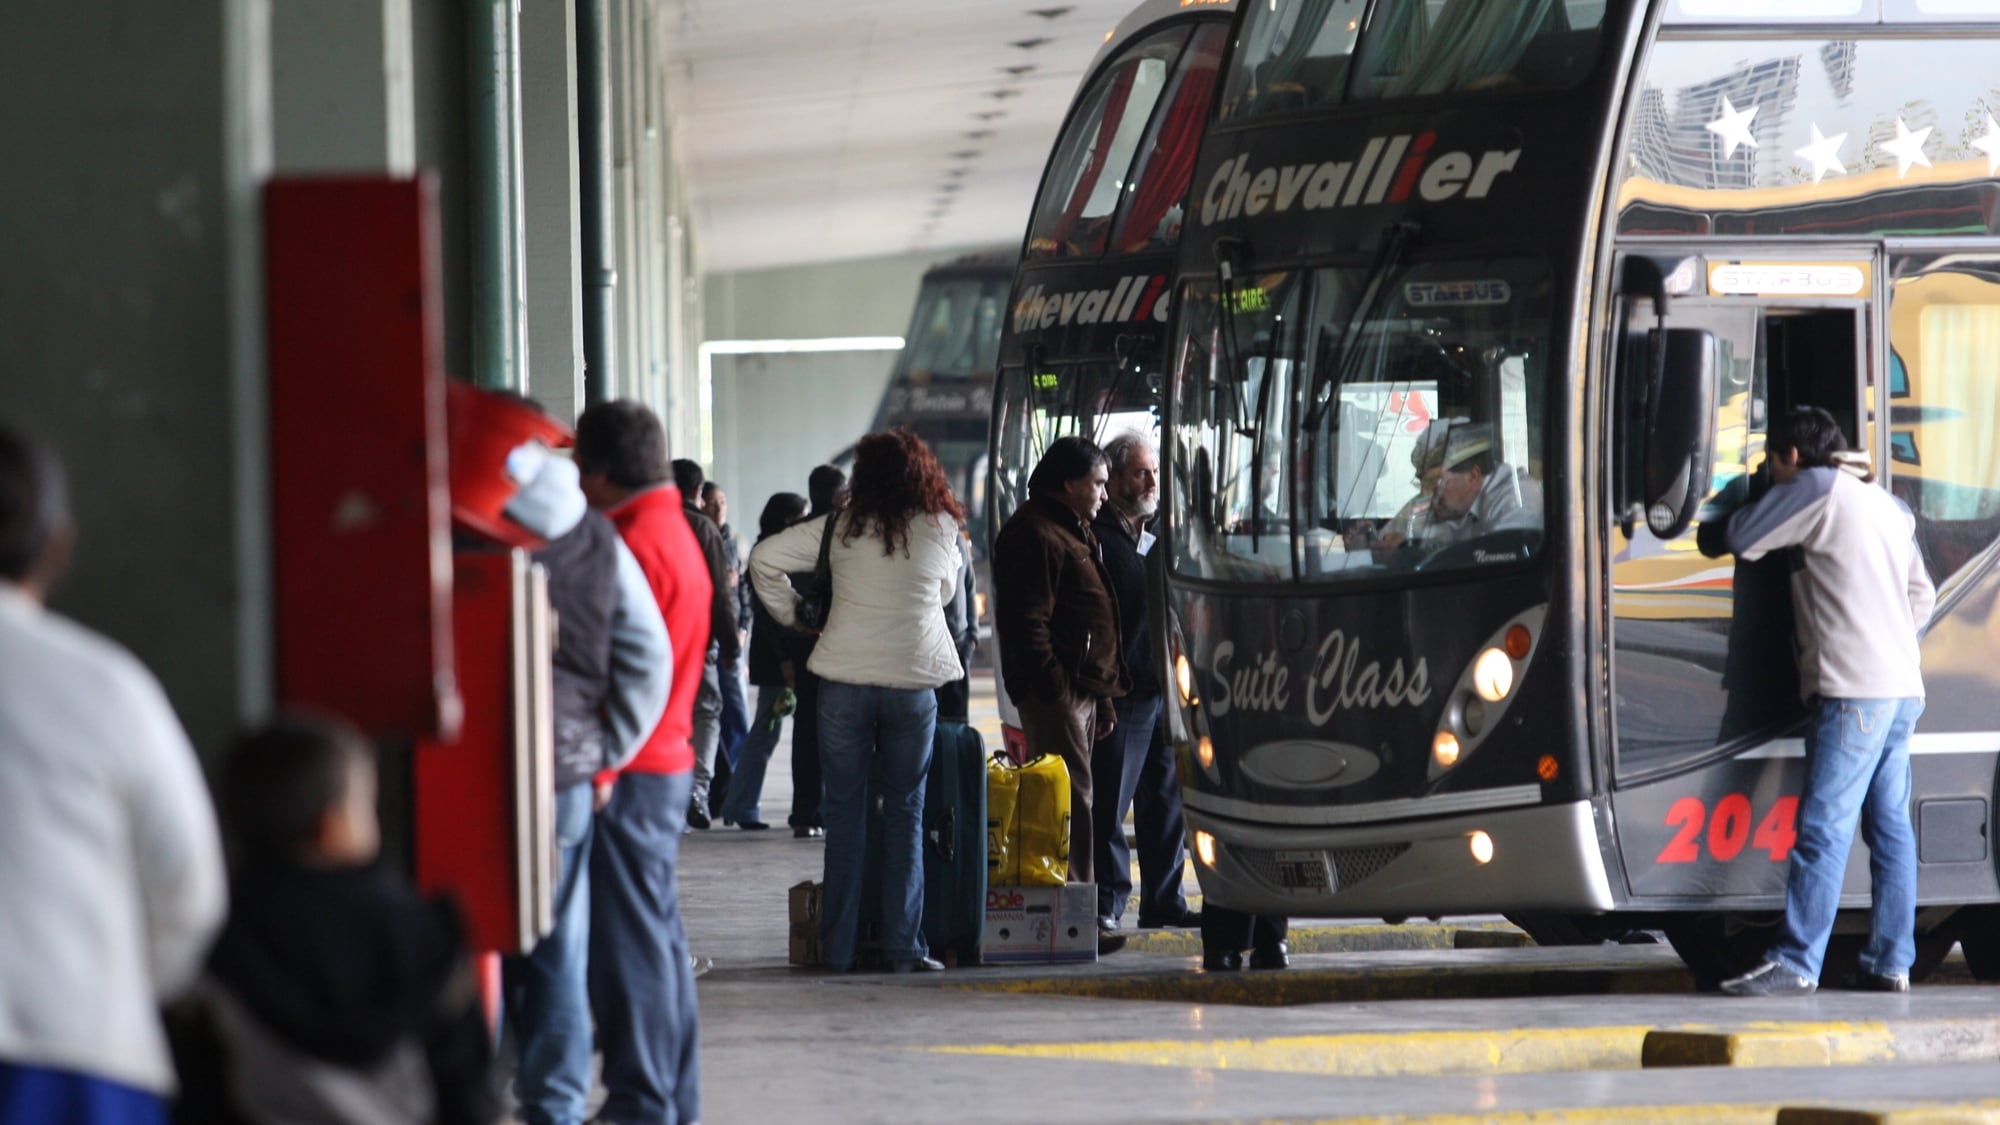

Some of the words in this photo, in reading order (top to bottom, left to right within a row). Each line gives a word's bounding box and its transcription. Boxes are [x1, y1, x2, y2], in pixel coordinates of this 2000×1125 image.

[1201, 131, 1522, 226] Chevallier
[1210, 640, 1290, 718] Suite
[1306, 628, 1432, 726] Class
[1655, 792, 1800, 863] 204
[986, 890, 1025, 908] Dole
